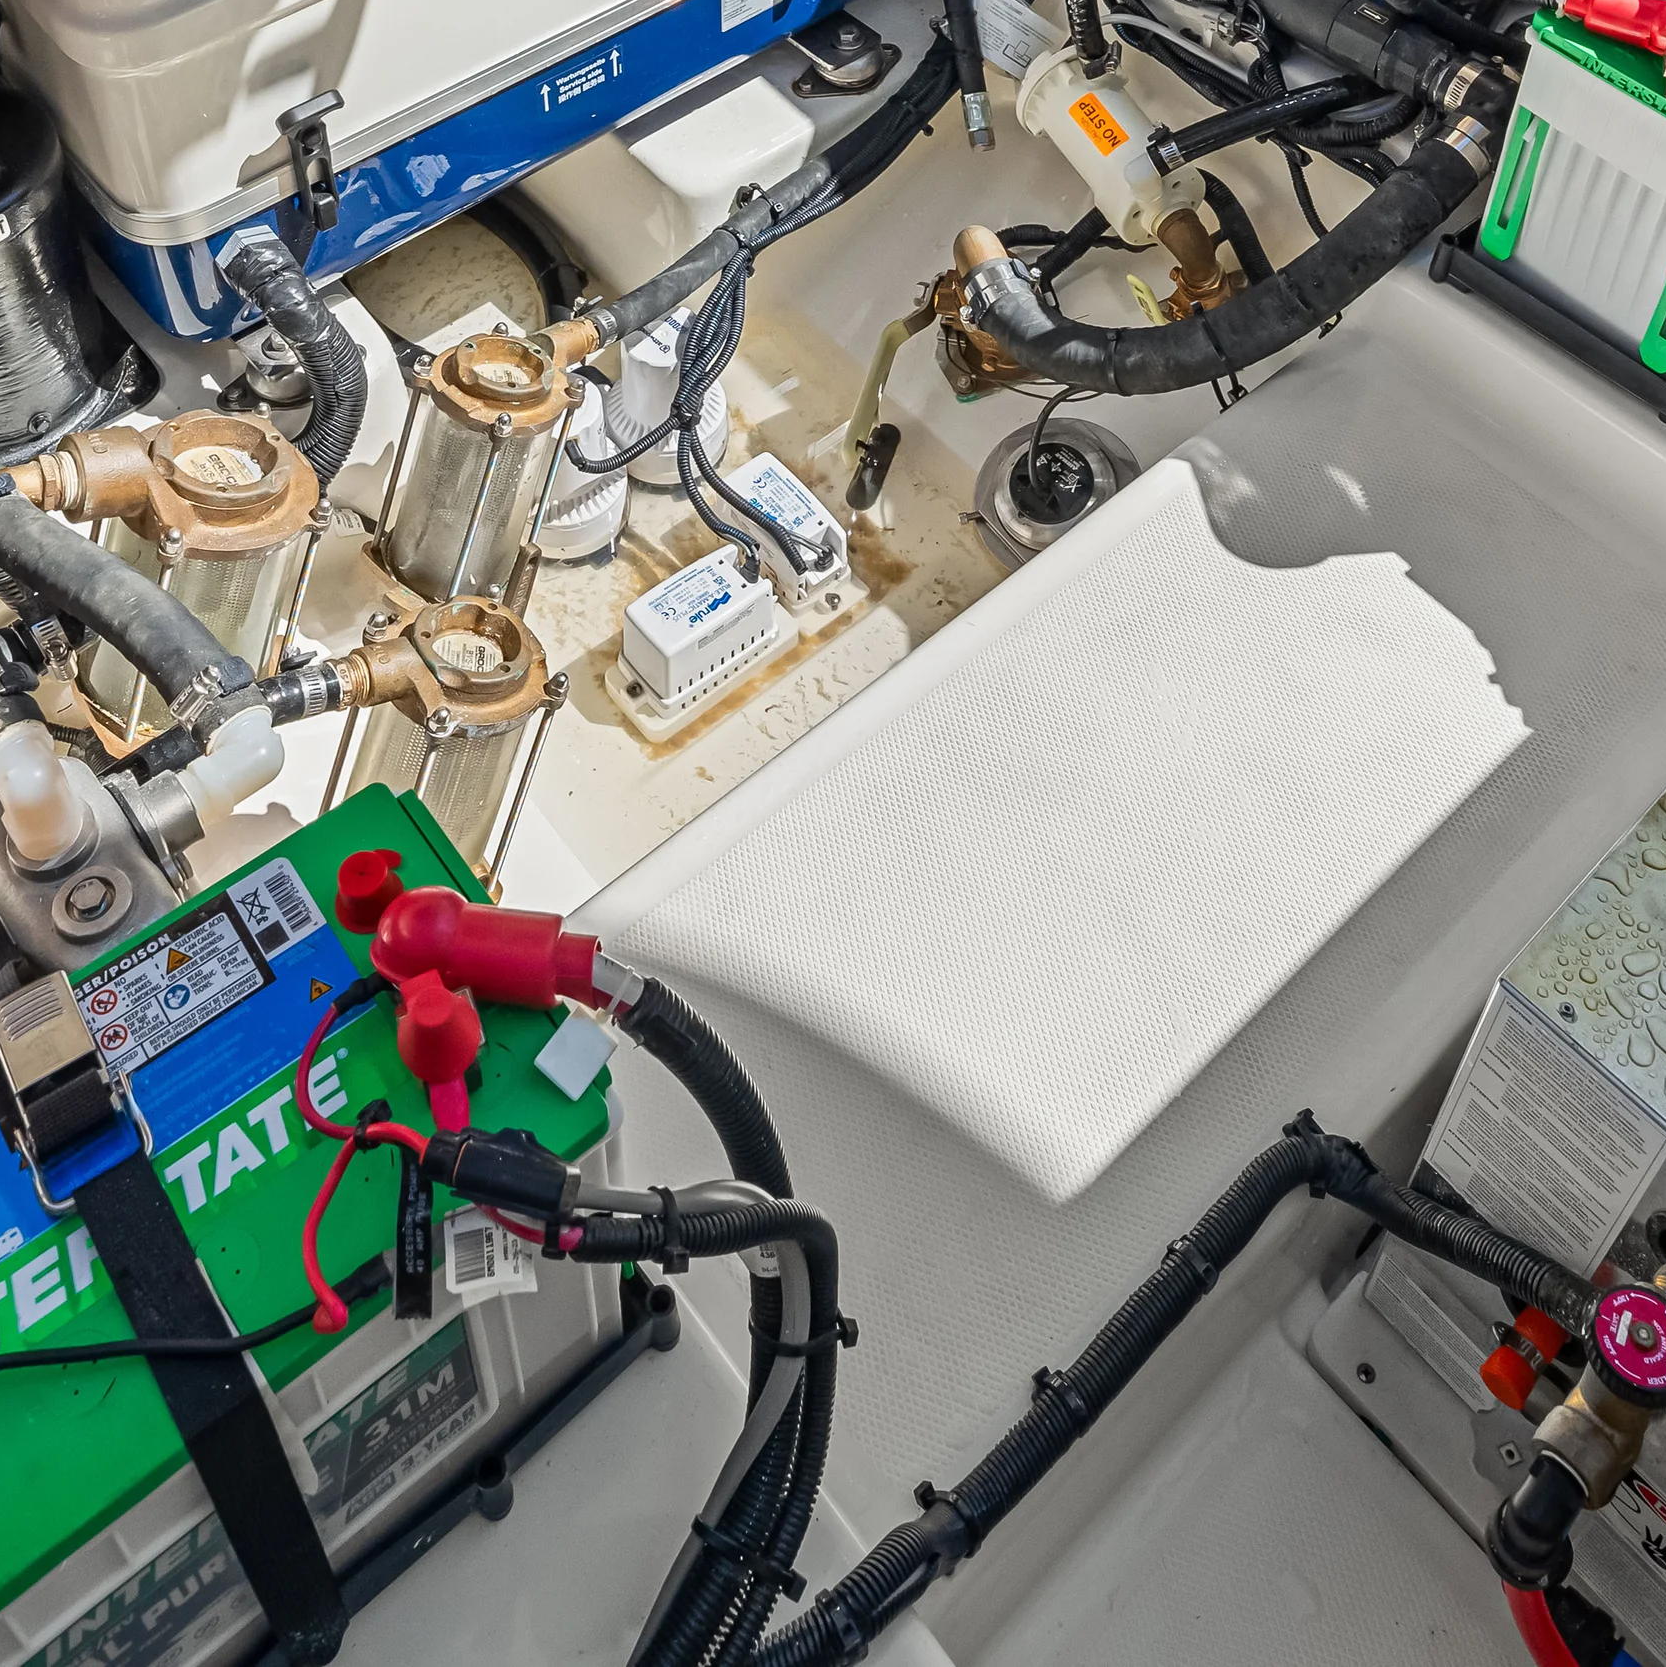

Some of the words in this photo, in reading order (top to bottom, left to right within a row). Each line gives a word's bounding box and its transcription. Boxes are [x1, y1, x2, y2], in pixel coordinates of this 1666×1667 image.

[555, 57, 606, 85] Wartungsseite
[558, 75, 586, 93] Service
[585, 67, 603, 79] side
[1078, 101, 1105, 130] STEP
[1101, 127, 1120, 147] NO
[476, 645, 485, 672] GROC
[173, 924, 209, 950] SULFURIC
[206, 913, 225, 929] ACID
[254, 913, 269, 926] Pb
[182, 939, 199, 953] CAN
[197, 928, 217, 944] CAUSE
[189, 931, 225, 957] BLINDNESS
[224, 944, 240, 958] NOT
[174, 958, 197, 977] SEVERE
[219, 954, 238, 970] OPEN
[112, 975, 127, 988] NO
[121, 971, 147, 991] SPARKS
[185, 967, 204, 983] READ
[191, 978, 214, 996] TIONS.
[125, 978, 152, 998] FLAMES
[128, 981, 162, 1005] SMOKING
[121, 1008, 139, 1023] KEEP
[137, 1000, 153, 1013] OUT
[134, 1011, 149, 1024] THE
[147, 1029, 170, 1047] REPAIR
[167, 1013, 195, 1035] SHOULD
[193, 1003, 211, 1019] ONLY
[218, 972, 258, 1003] PERFORMED
[165, 1018, 199, 1043] QUALIFIED
[196, 1004, 221, 1023] SERVICE
[218, 977, 259, 1009] TECHNICIAN.
[128, 1018, 151, 1036] REACH
[131, 1017, 167, 1043] CHILDREN.
[408, 1163, 416, 1201] POWER
[416, 1191, 426, 1223] FUSE
[407, 1208, 415, 1273] ACCESSORY
[357, 1366, 456, 1448] 31M
